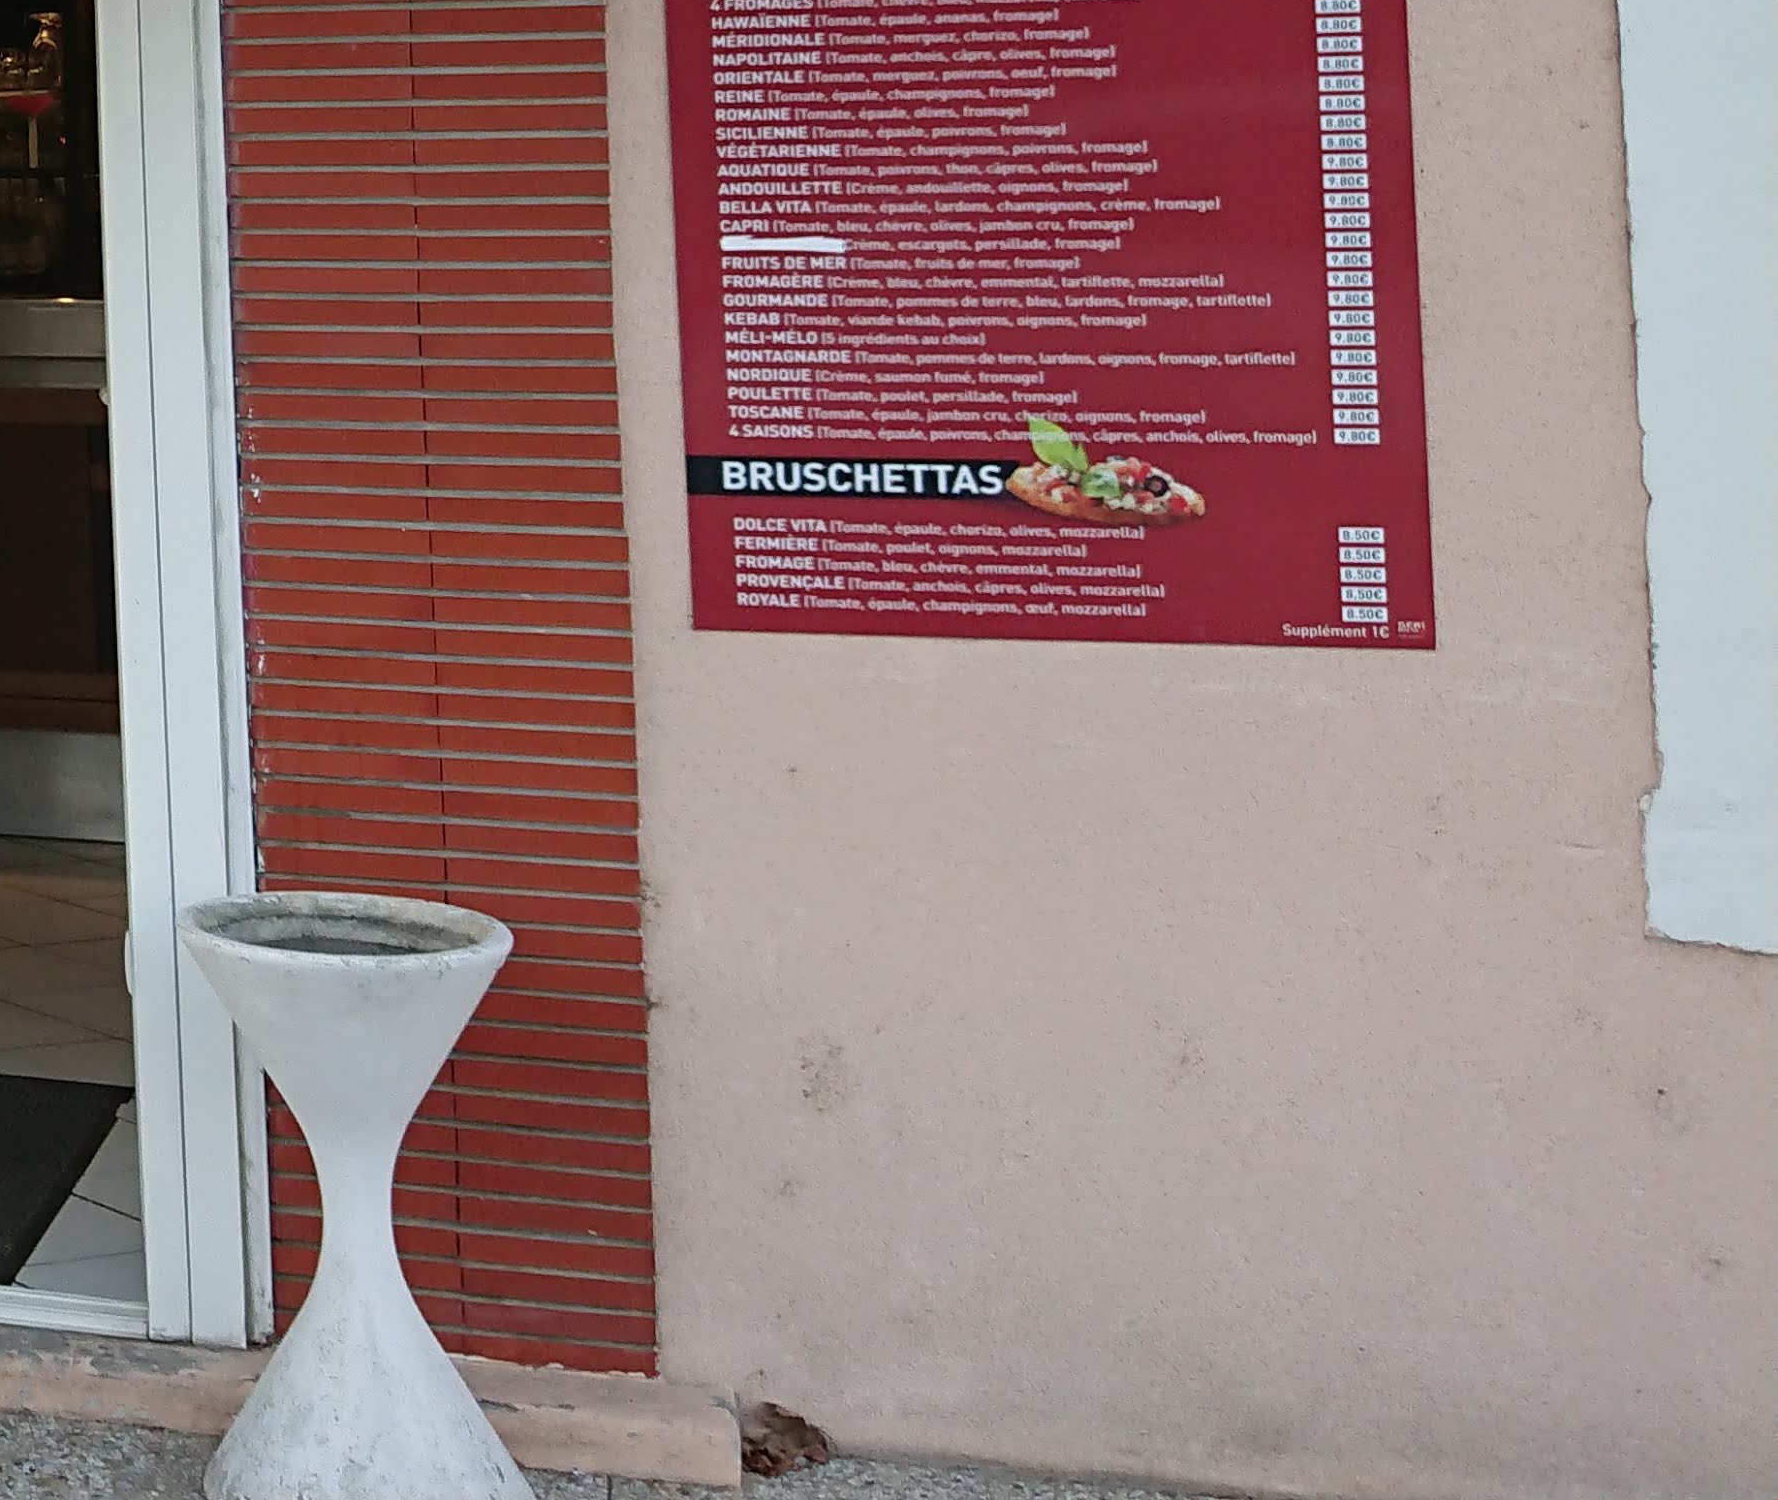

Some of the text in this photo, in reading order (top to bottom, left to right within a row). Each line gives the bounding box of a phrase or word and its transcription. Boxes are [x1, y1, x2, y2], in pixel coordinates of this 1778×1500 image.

[711, 31, 826, 48] MÉRIDIONALE
[712, 51, 822, 67] NAPOLITAINE
[713, 69, 805, 85] ORIENTALE
[714, 88, 765, 104] REINE
[715, 107, 791, 122] ROMAINE
[715, 125, 809, 141] SICILIENNE
[716, 141, 842, 159] VÉGÉTARIENNE
[717, 162, 810, 177] AQUATIQUE
[718, 180, 842, 196] ANDOUILLETTE
[719, 200, 773, 215] BELLA
[775, 200, 813, 214] VITA
[719, 219, 769, 233] CAPRI
[721, 256, 846, 270] FRUITS DE MER
[723, 293, 829, 308] GOURMANDE
[724, 312, 781, 326] KEBAB
[725, 327, 818, 345] MÉLI-MÉLO
[725, 349, 851, 364] MONTAGNARDE
[726, 367, 812, 383] NORDIQUE
[727, 386, 812, 401] POULETTE
[728, 405, 805, 420] TOSCANE
[728, 423, 739, 438] 4
[742, 423, 814, 439] SAISONS
[721, 460, 1004, 496] BRUSCHETTAS
[733, 517, 828, 533] DOLCE VITA
[734, 554, 816, 571] FROMAGE
[735, 573, 846, 592] PROVENÇALE
[736, 592, 802, 608] ROYALE
[1282, 623, 1367, 639] Supplément
